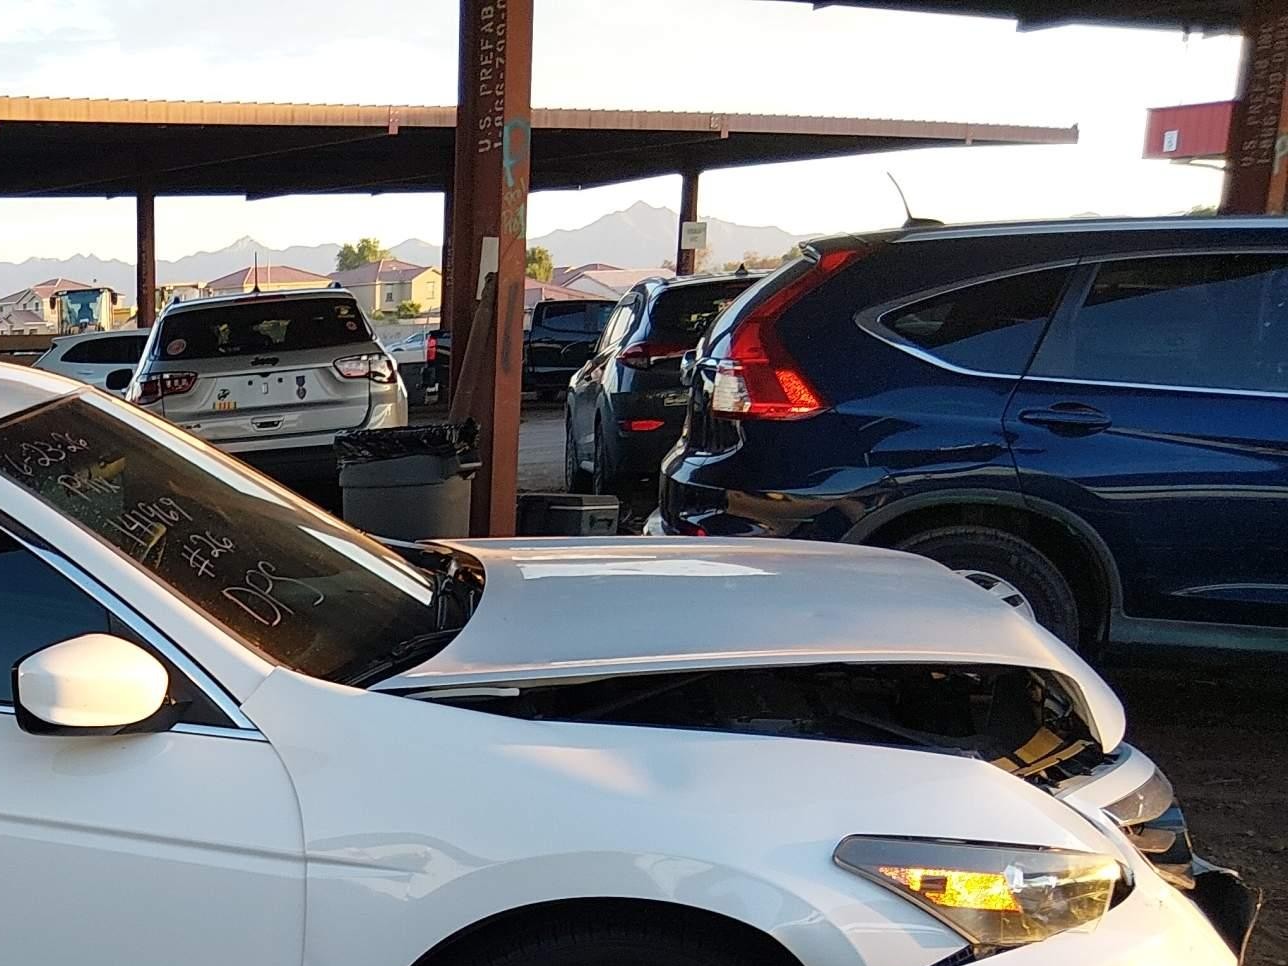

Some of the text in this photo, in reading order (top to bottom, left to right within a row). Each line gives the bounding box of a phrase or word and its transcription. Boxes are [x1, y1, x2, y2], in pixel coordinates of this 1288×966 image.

[480, 5, 494, 96] PREFAB
[181, 531, 234, 578] #26
[221, 560, 325, 627] DPS
